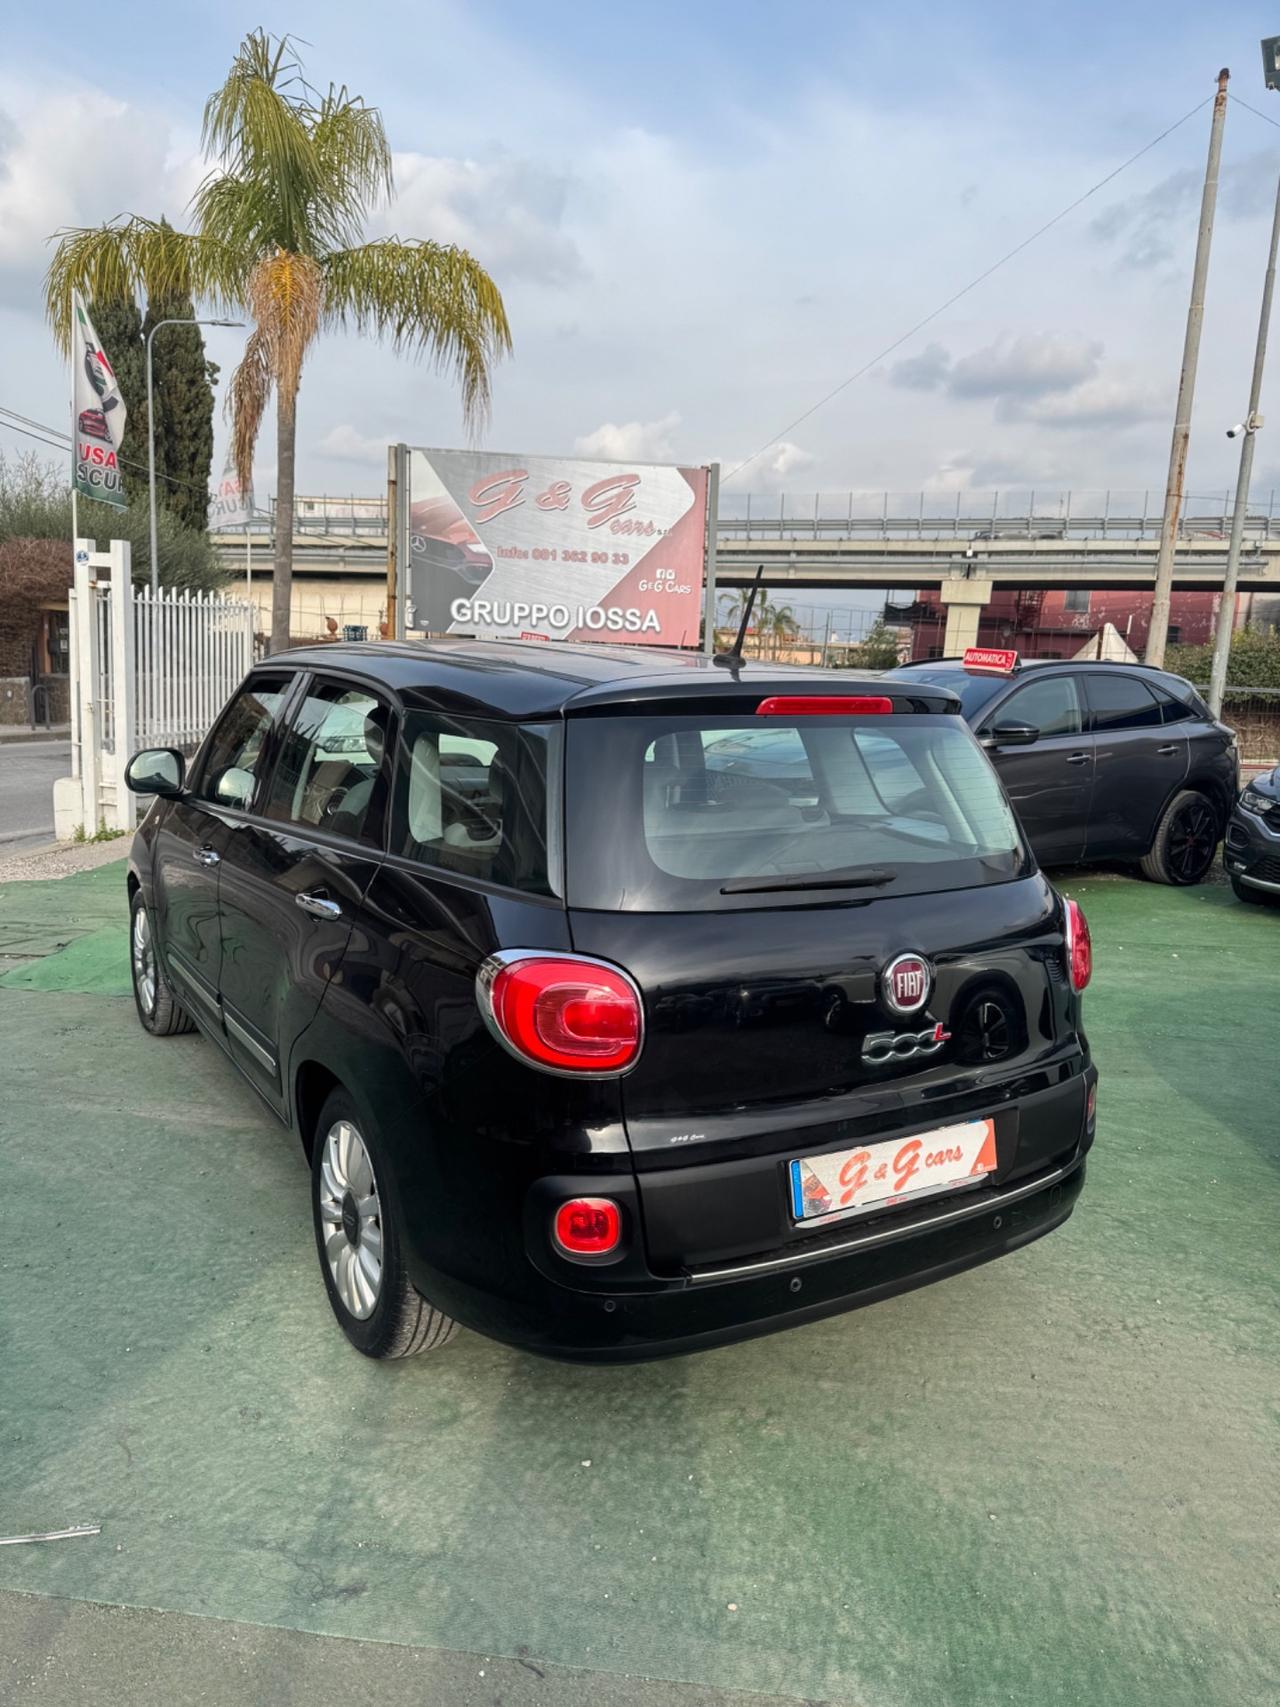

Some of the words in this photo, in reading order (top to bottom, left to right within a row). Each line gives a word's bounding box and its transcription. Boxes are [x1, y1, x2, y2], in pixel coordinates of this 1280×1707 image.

[469, 469, 529, 524] G
[536, 480, 571, 511] &
[580, 473, 640, 530] G
[532, 548, 557, 561] 081
[612, 553, 629, 565] 33
[450, 598, 569, 628] GRUPPO
[577, 607, 661, 632] IOSSA
[965, 652, 1006, 664] AUTOMATICA
[896, 971, 922, 998] FIAT
[862, 1022, 951, 1064] 500L
[838, 1151, 871, 1204] G
[874, 1163, 887, 1180] &
[893, 1139, 923, 1191] G
[925, 1146, 963, 1168] cars
